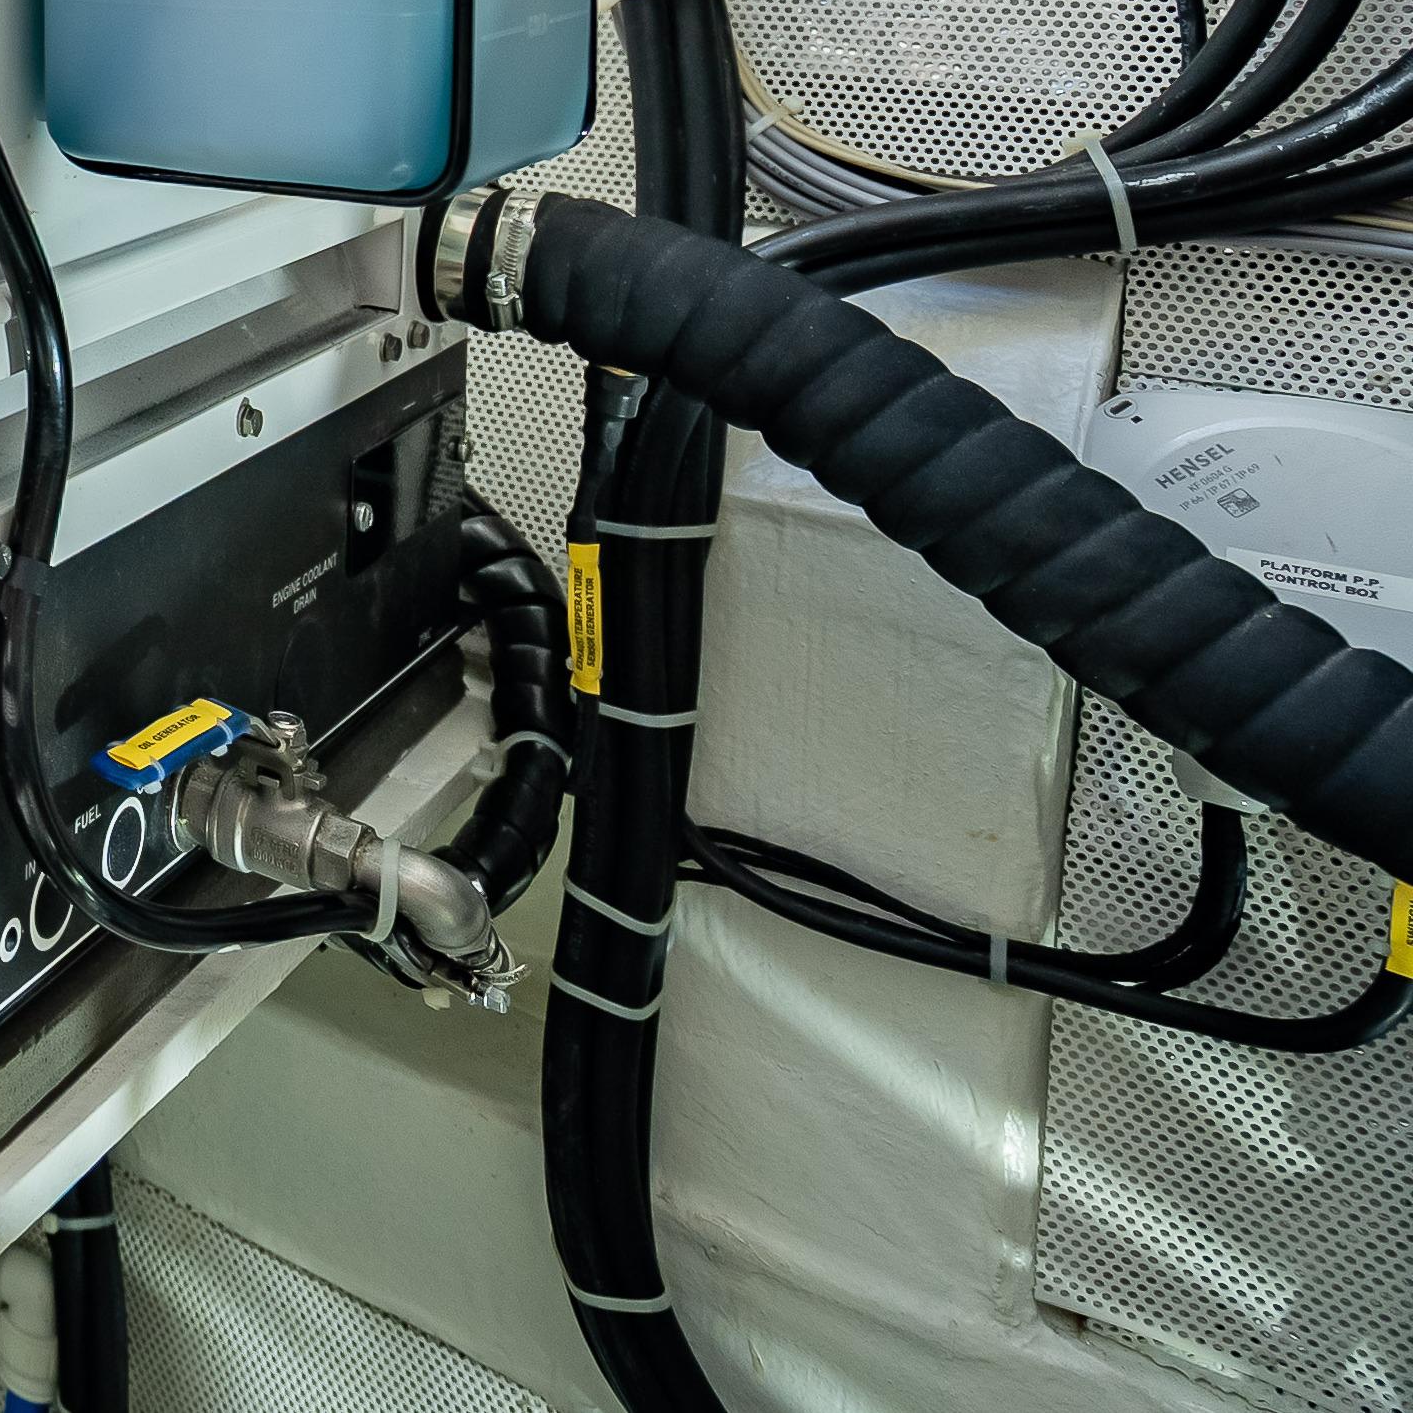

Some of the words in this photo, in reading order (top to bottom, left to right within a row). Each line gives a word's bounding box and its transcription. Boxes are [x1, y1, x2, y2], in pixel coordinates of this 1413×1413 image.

[1155, 444, 1235, 489] HENSEL
[1179, 501, 1190, 511] IP
[273, 577, 301, 608] ENGINE
[302, 552, 338, 587] COOLANT
[1260, 559, 1348, 582] PLATFORM
[1263, 571, 1341, 593] CONTROL
[1345, 585, 1379, 600] BOX
[293, 587, 317, 614] DRAIN
[574, 567, 583, 635] TEMPERATURE
[585, 577, 595, 636] GENERATOR
[137, 739, 151, 750] OIL
[152, 713, 202, 742] GENERATOR
[74, 803, 101, 835] FUEL
[25, 859, 36, 881] IN
